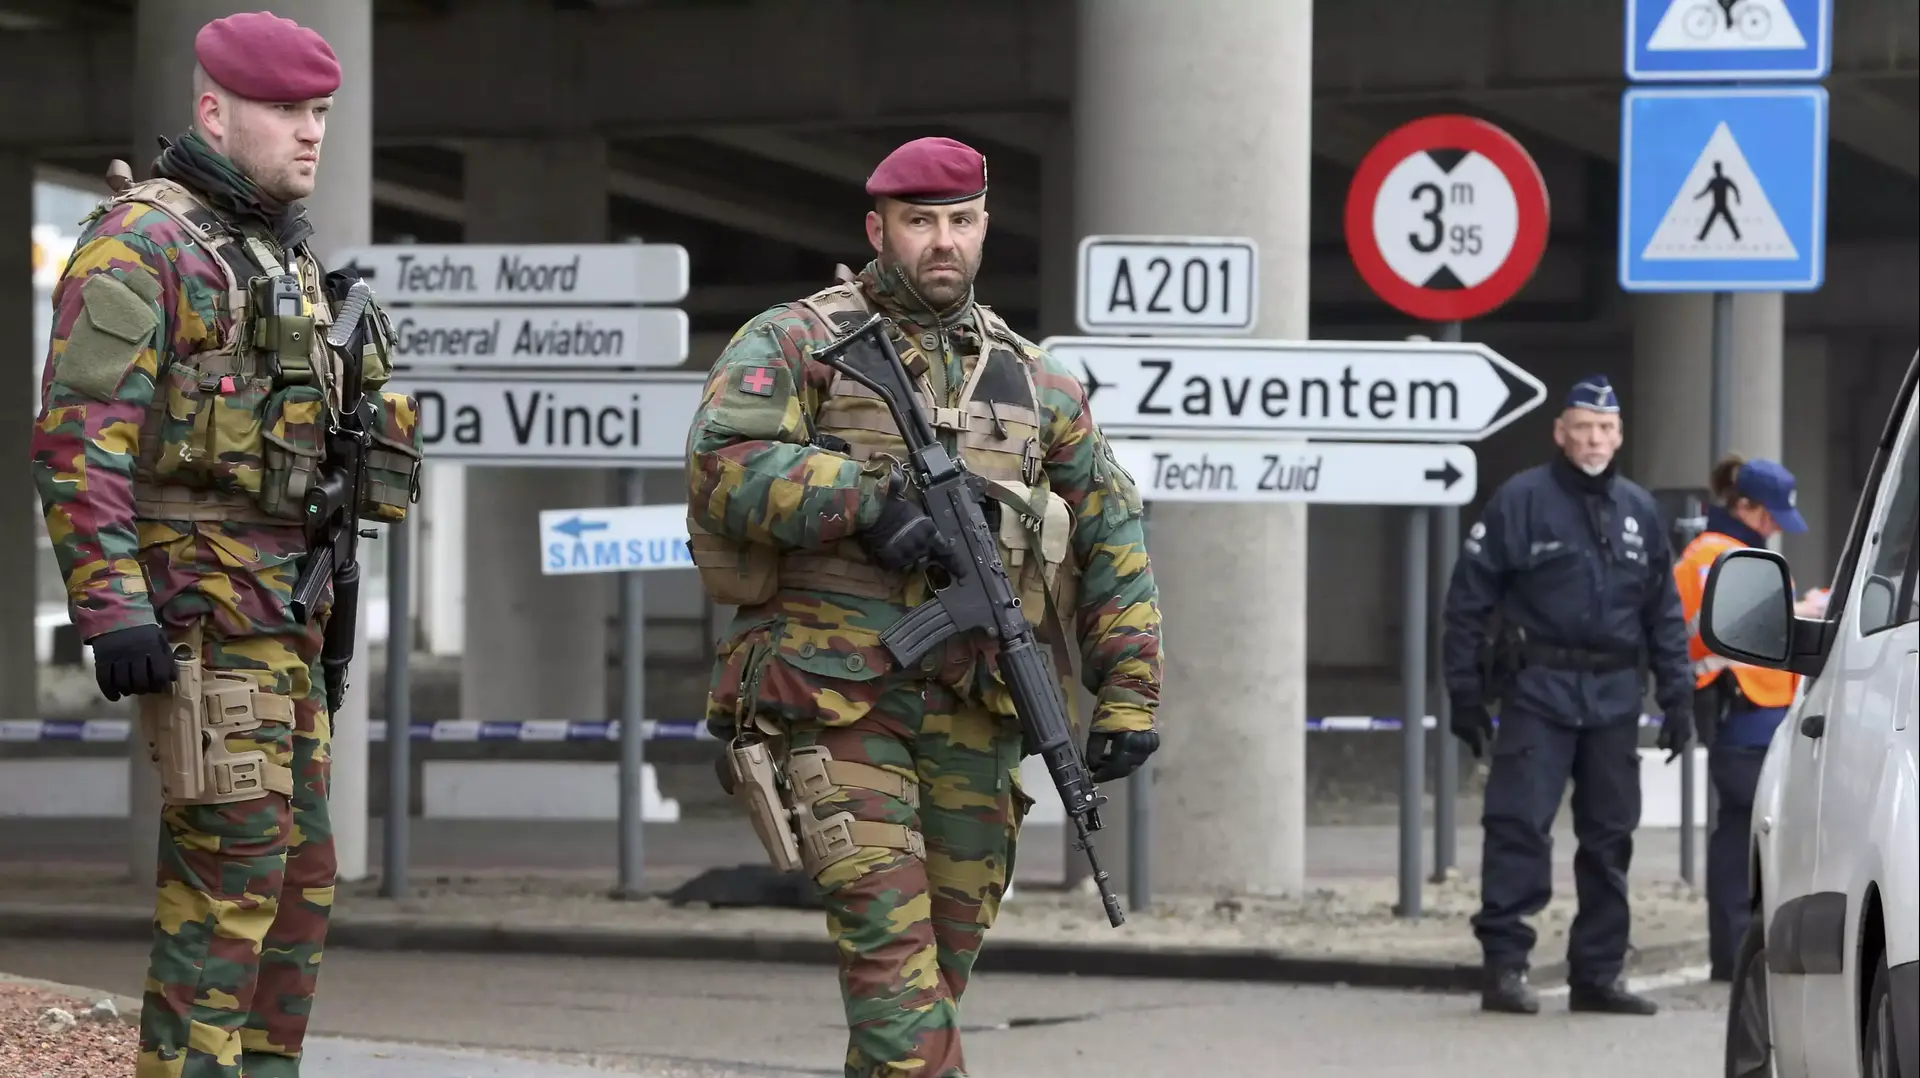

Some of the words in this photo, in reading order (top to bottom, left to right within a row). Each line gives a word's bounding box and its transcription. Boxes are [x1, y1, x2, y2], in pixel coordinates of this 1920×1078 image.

[1408, 182, 1445, 254] 3
[1450, 182, 1475, 205] m
[1449, 224, 1483, 256] 95
[396, 254, 477, 293] Techn.
[495, 255, 580, 292] Noord
[1107, 256, 1230, 315] A201
[396, 317, 500, 357] General
[512, 319, 624, 357] Aviation
[1137, 359, 1460, 420] Zaventem
[414, 390, 482, 445] Da
[503, 390, 641, 447] Vinci
[1152, 453, 1238, 492] Techn.
[1256, 455, 1323, 493] Zuid
